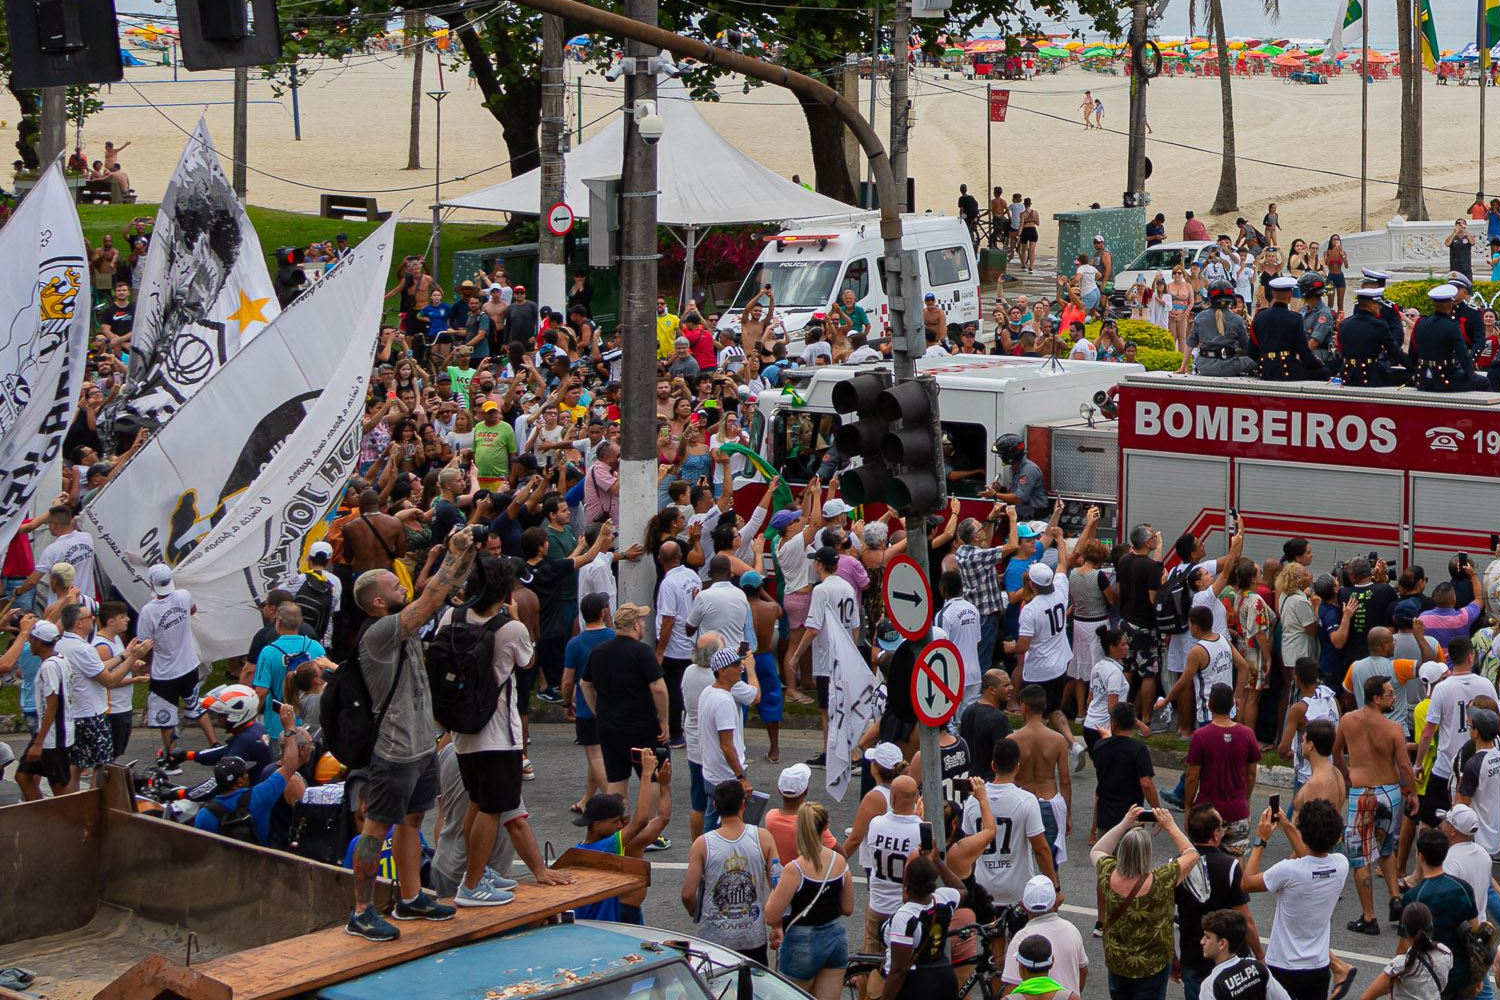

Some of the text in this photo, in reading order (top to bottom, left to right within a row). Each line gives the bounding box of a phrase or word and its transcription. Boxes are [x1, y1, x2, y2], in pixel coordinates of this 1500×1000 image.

[1134, 400, 1397, 454] BOMBEIROS
[837, 598, 854, 624] 10
[1045, 602, 1066, 636] 10
[876, 834, 910, 852] PELÉ
[873, 849, 908, 884] 10
[984, 860, 1012, 870] FELIPE
[1225, 964, 1260, 990] UELPA
